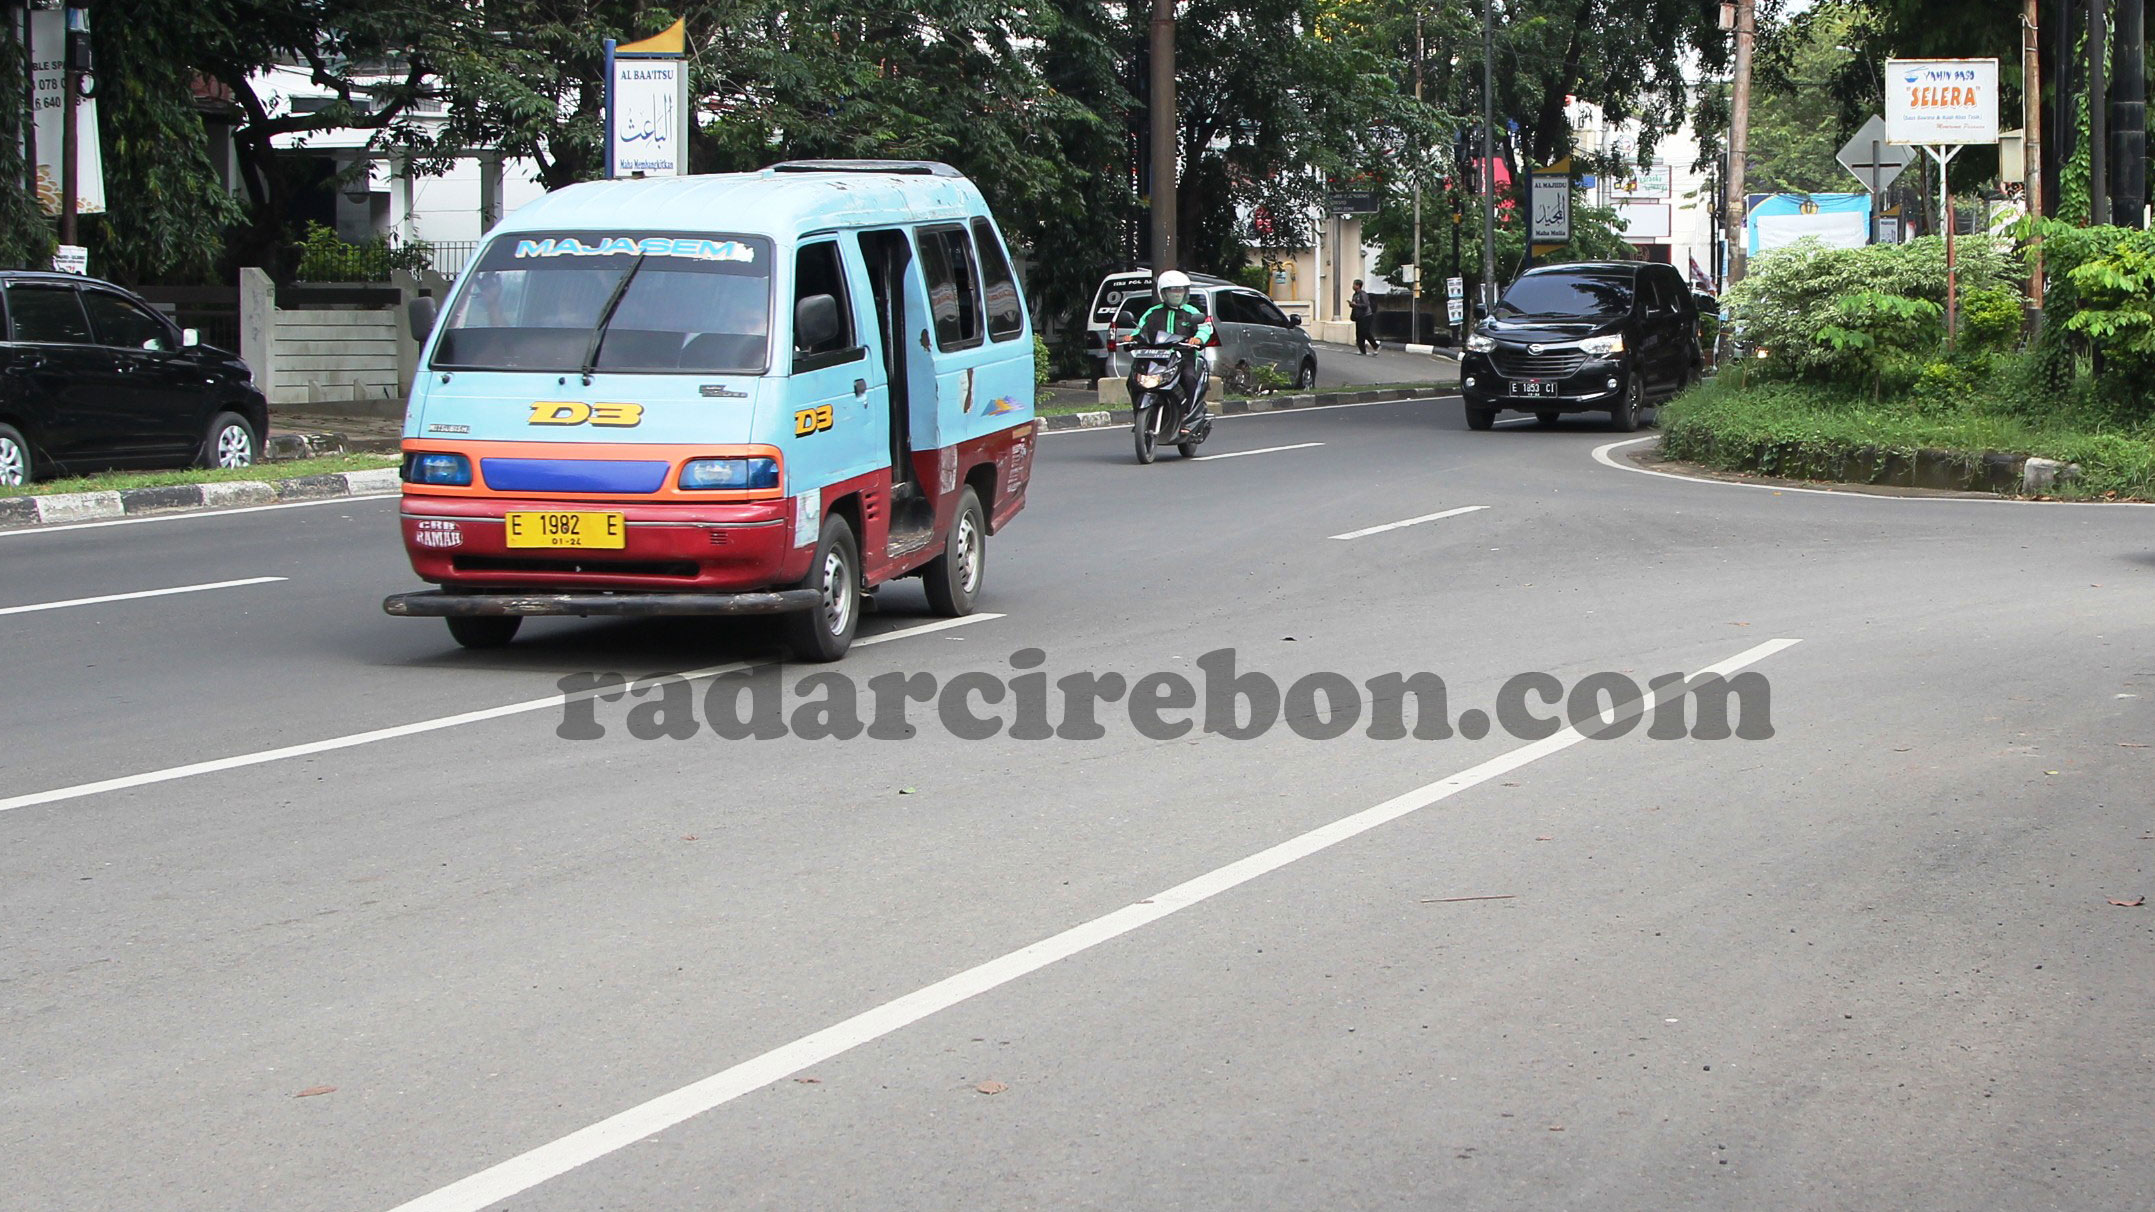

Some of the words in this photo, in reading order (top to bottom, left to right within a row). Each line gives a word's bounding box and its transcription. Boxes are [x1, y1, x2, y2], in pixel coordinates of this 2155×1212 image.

[620, 70, 632, 80] AL
[515, 237, 739, 260] MAJASEM
[1512, 383, 1517, 392] E
[1523, 383, 1540, 392] 1853
[528, 401, 644, 427] D3
[794, 404, 834, 439] D3
[512, 515, 523, 535] E
[540, 514, 580, 535] 1982
[607, 515, 618, 536] E
[416, 530, 462, 548] RAMAH
